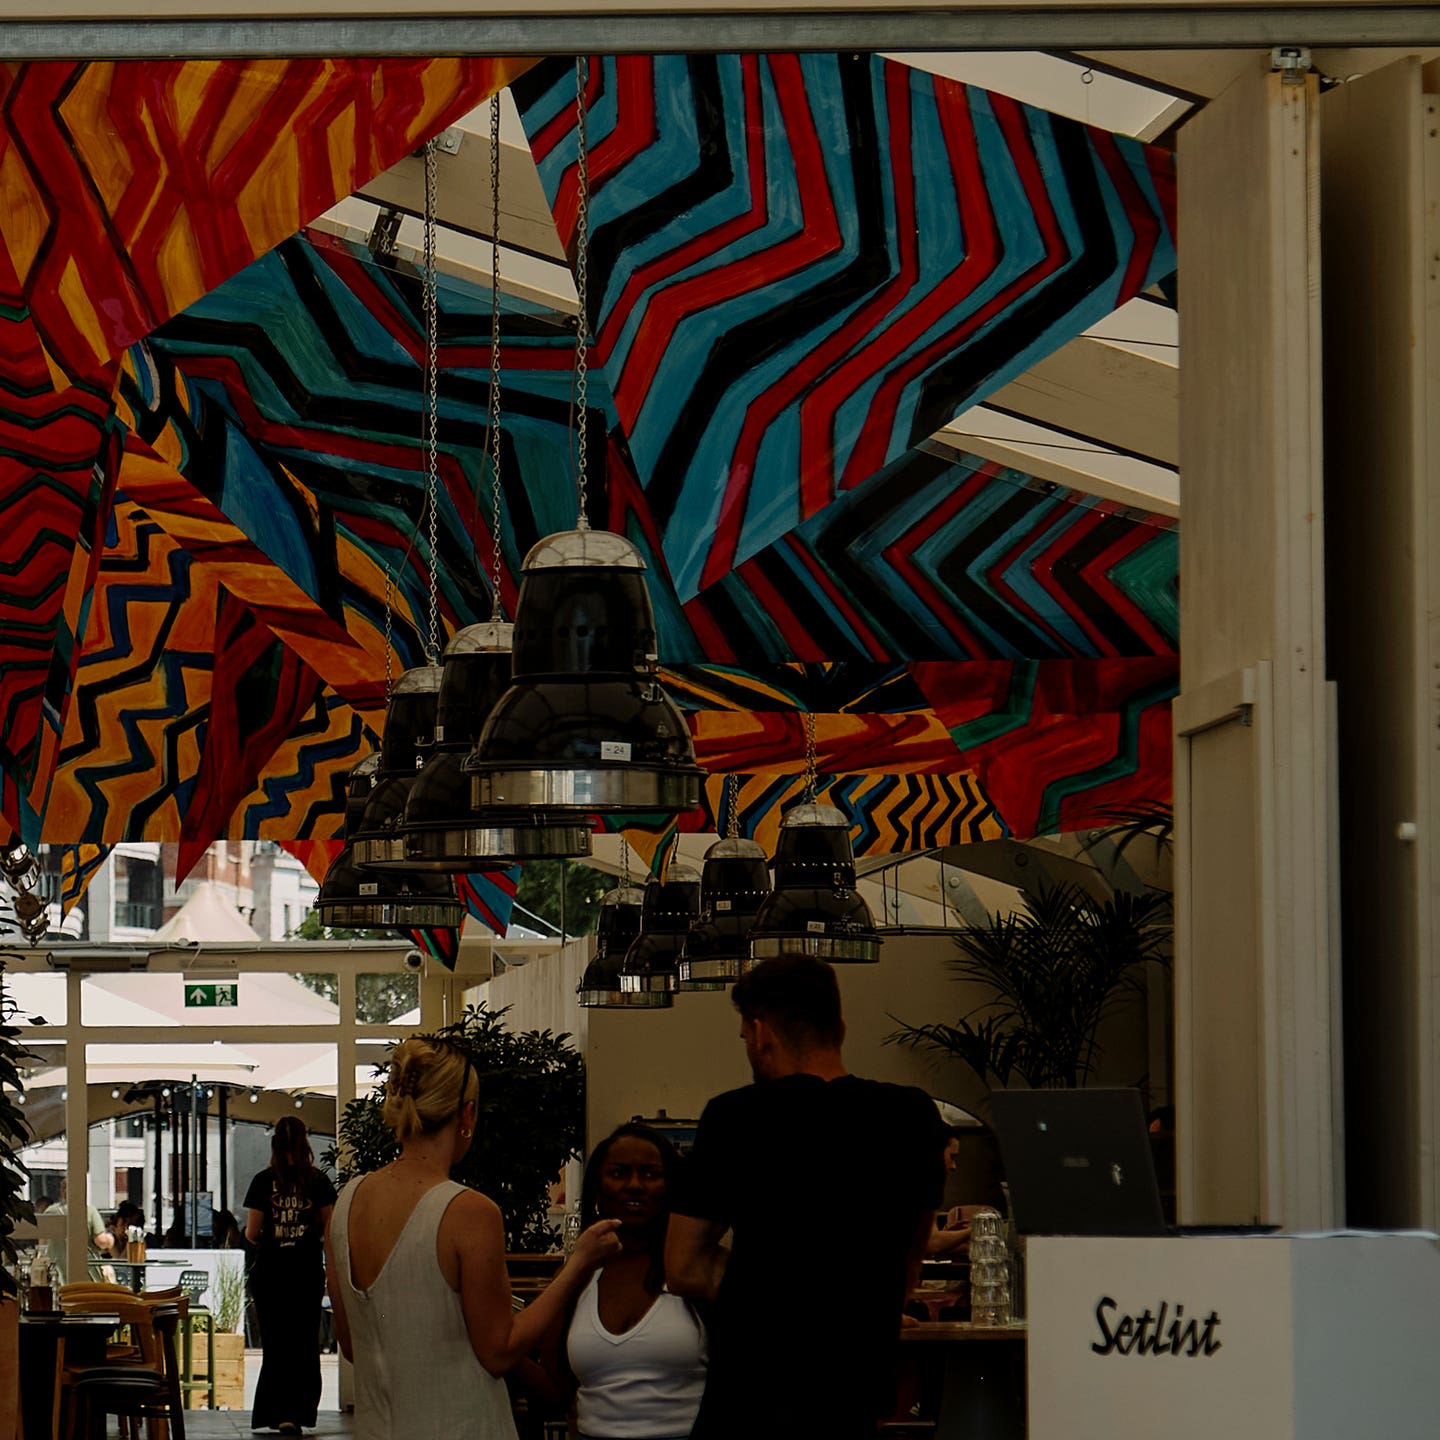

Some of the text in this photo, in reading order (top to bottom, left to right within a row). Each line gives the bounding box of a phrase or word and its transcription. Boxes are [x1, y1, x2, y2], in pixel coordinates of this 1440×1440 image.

[279, 1196, 304, 1209] FOOD
[280, 1210, 300, 1224] ART
[274, 1224, 305, 1239] MUSIC
[1091, 1296, 1222, 1358] Setlist
